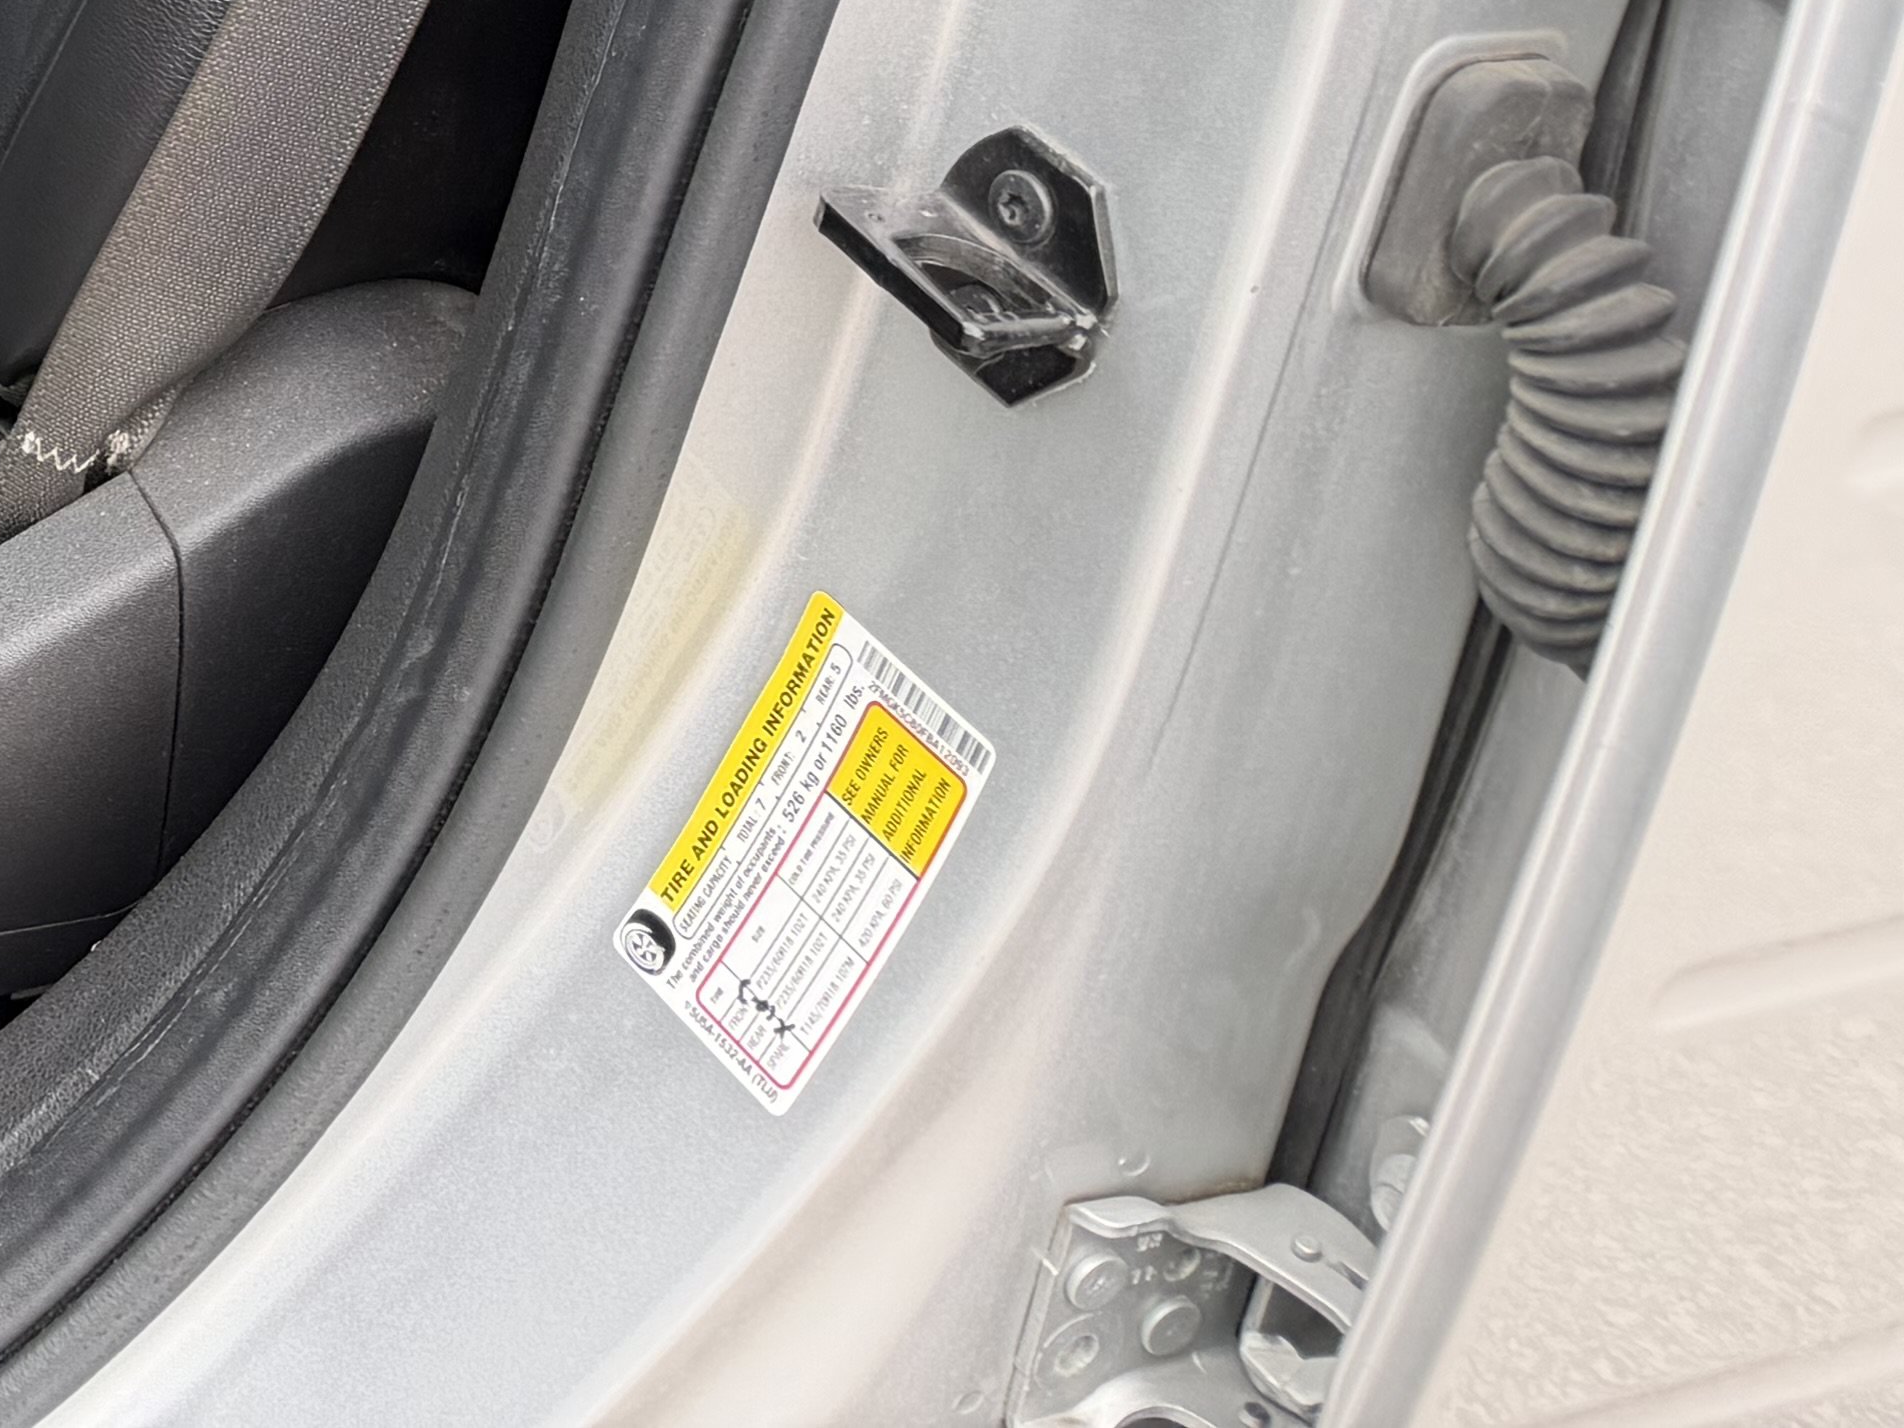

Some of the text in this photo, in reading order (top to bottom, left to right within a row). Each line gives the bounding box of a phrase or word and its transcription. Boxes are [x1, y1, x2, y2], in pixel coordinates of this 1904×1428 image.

[829, 661, 841, 675] 5
[659, 606, 836, 902] TIRE AND LOADING INFORMATION
[794, 729, 807, 743] 2
[841, 726, 889, 806] SEE OWNERS
[754, 796, 766, 811] 7
[859, 743, 909, 825] MANUAL FOR
[881, 767, 927, 842] ADDITIONAL
[899, 776, 952, 864] INFORMATION
[688, 960, 705, 983] and
[701, 933, 724, 963] cargo
[720, 898, 746, 935] should
[742, 871, 763, 902] never
[760, 834, 786, 873] exceed
[781, 790, 806, 823] 526
[798, 770, 820, 792] kg
[813, 751, 827, 771] or
[820, 713, 848, 753] 1160
[842, 684, 865, 710] lbs.
[665, 826, 777, 989] The combined weight of occupants
[679, 854, 732, 933] SEATING CAPACITY
